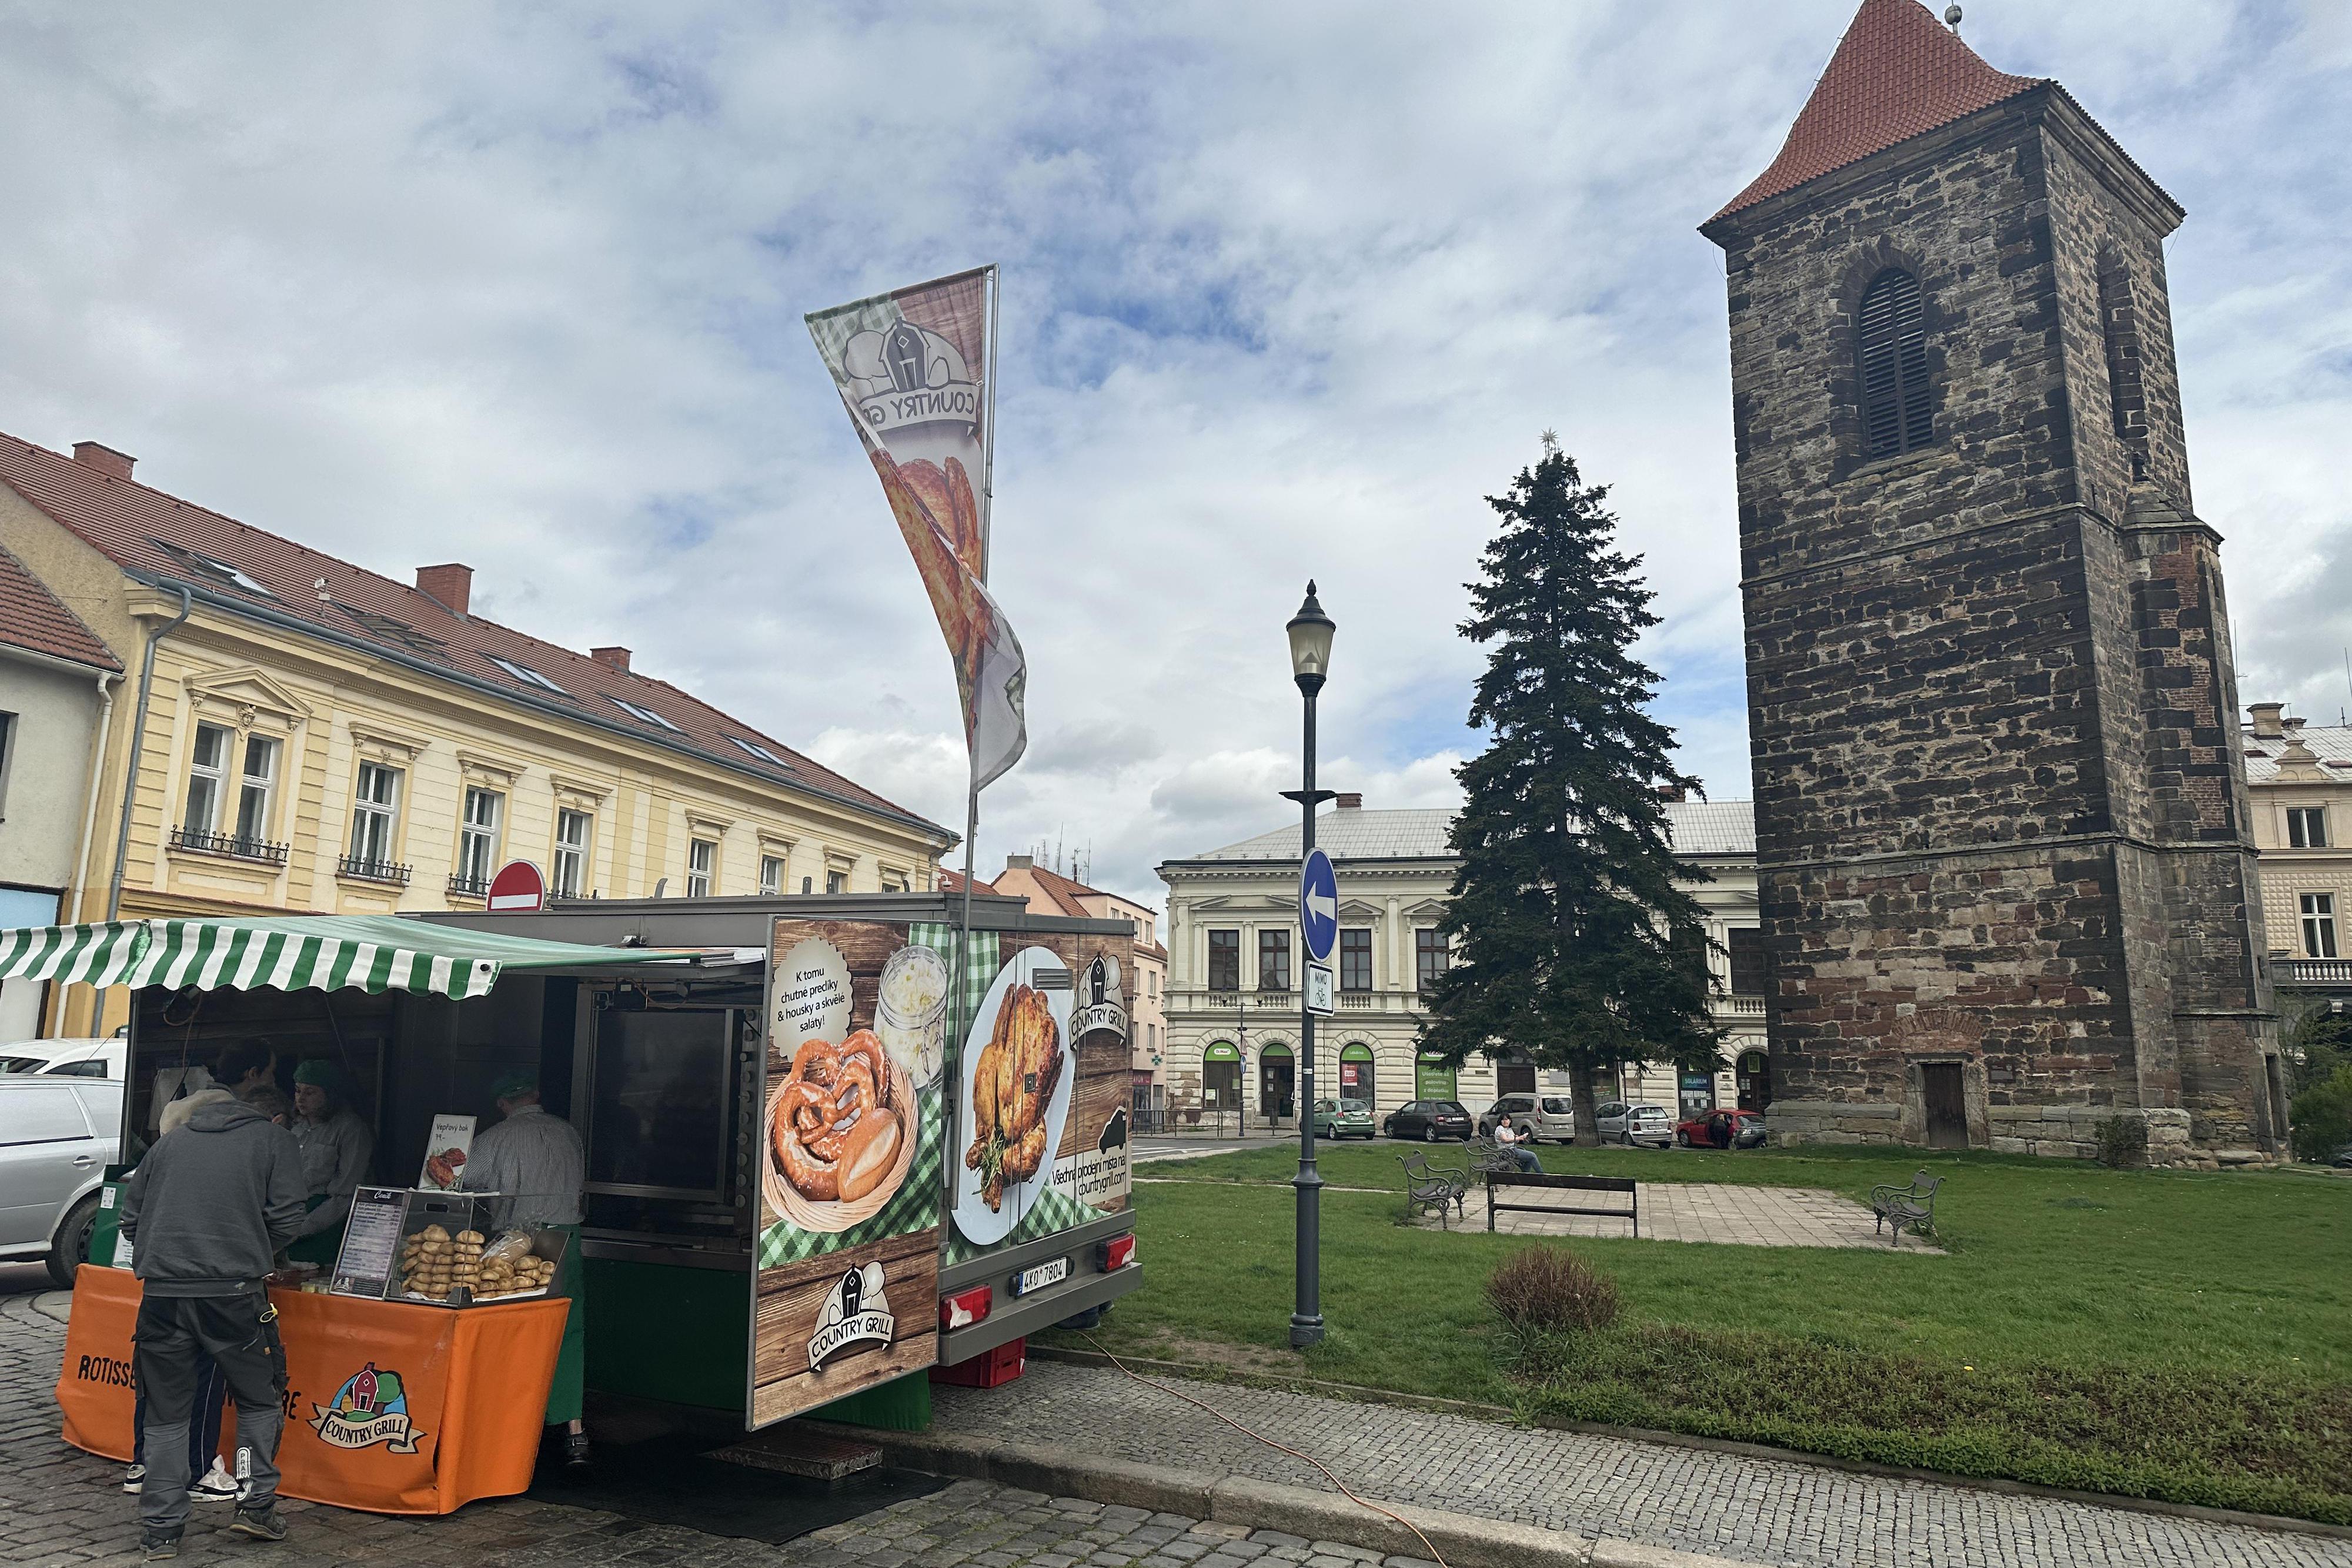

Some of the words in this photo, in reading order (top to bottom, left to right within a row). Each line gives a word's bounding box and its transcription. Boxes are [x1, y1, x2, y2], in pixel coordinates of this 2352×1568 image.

[796, 971, 802, 983] K
[803, 968, 824, 981] tomu
[781, 986, 808, 1004] chutné
[810, 979, 838, 998] preclíky
[777, 1011, 784, 1022] &
[786, 1002, 814, 1019] housky
[816, 1002, 820, 1010] a
[821, 992, 845, 1008] skvělé
[800, 1015, 825, 1032] saláty!
[1071, 1008, 1107, 1037] COUNTRY
[1108, 1009, 1125, 1032] GRILL
[436, 1124, 458, 1133] Vepřový
[459, 1124, 468, 1132] bok
[1077, 1157, 1102, 1183] prodejní
[1102, 1155, 1117, 1171] místa
[1118, 1155, 1125, 1167] na
[1044, 1261, 1063, 1283] 7804
[811, 1318, 864, 1358] COUNTRY
[866, 1317, 890, 1335] GRILL
[325, 1420, 372, 1443] COUNTRY
[373, 1419, 404, 1436] GRILL
